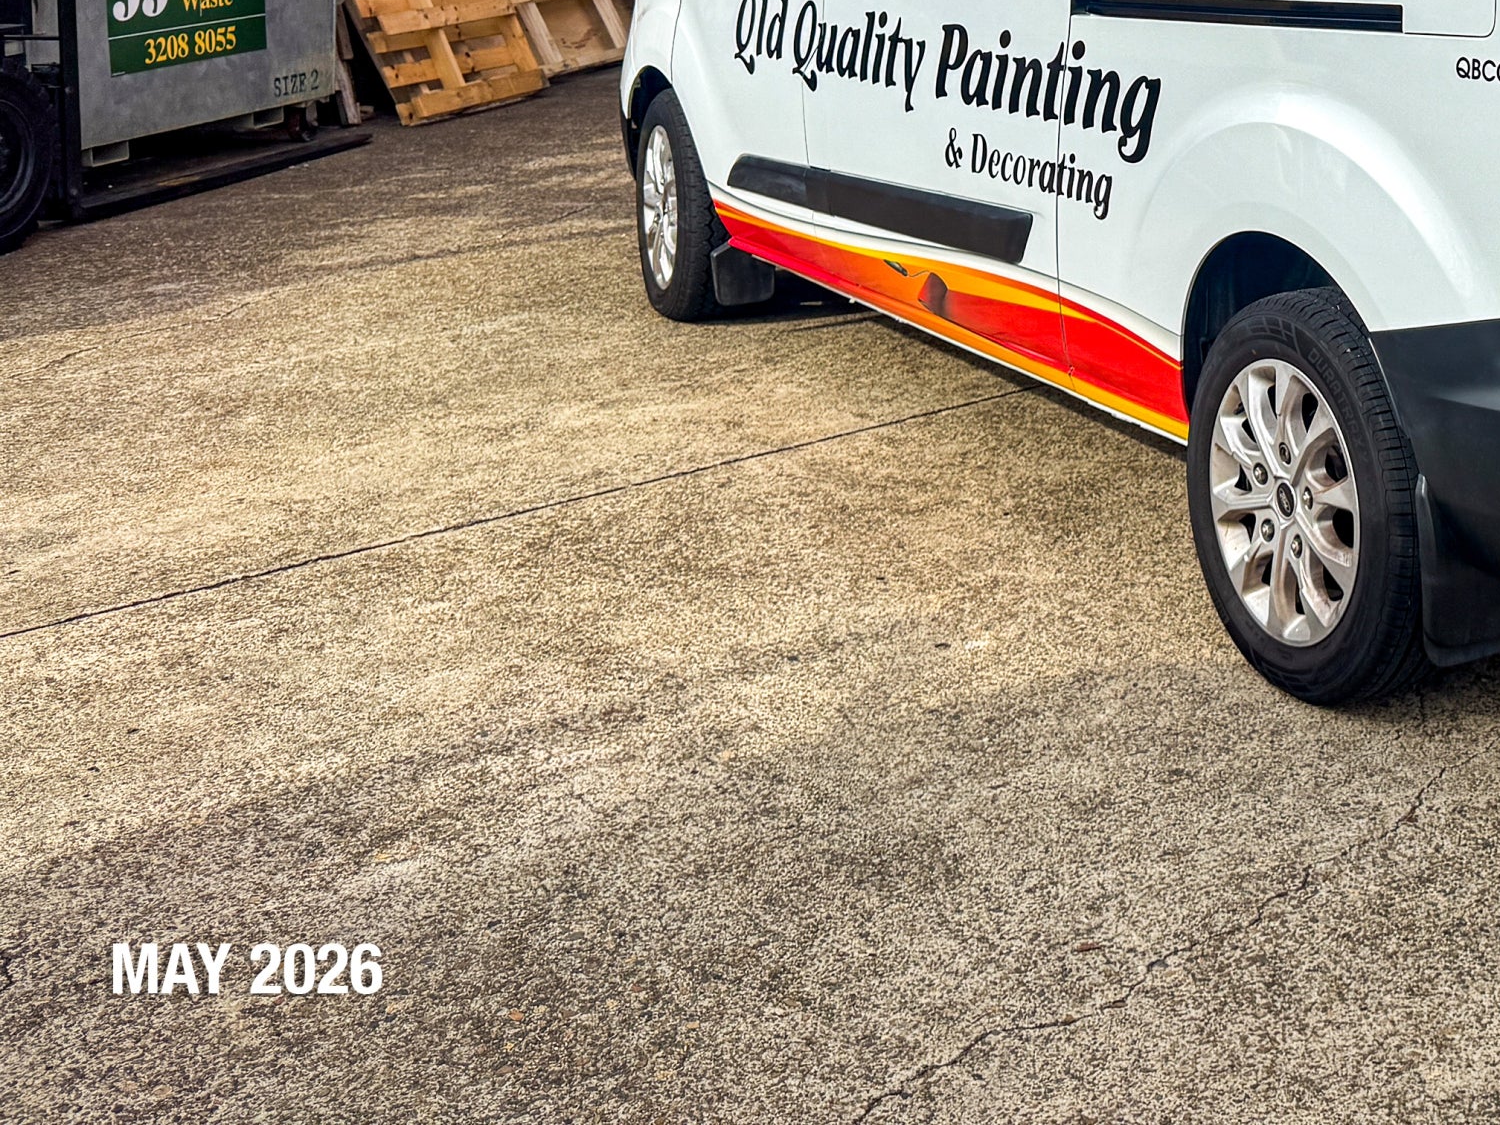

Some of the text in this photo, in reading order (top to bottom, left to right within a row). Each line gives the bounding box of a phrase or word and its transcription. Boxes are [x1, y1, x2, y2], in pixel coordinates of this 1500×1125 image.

[144, 26, 236, 65] 3208 8055
[274, 69, 319, 98] SIZE 2
[792, 0, 927, 113] Quality
[935, 23, 1162, 164] Painting
[945, 127, 1113, 221] & Decorating
